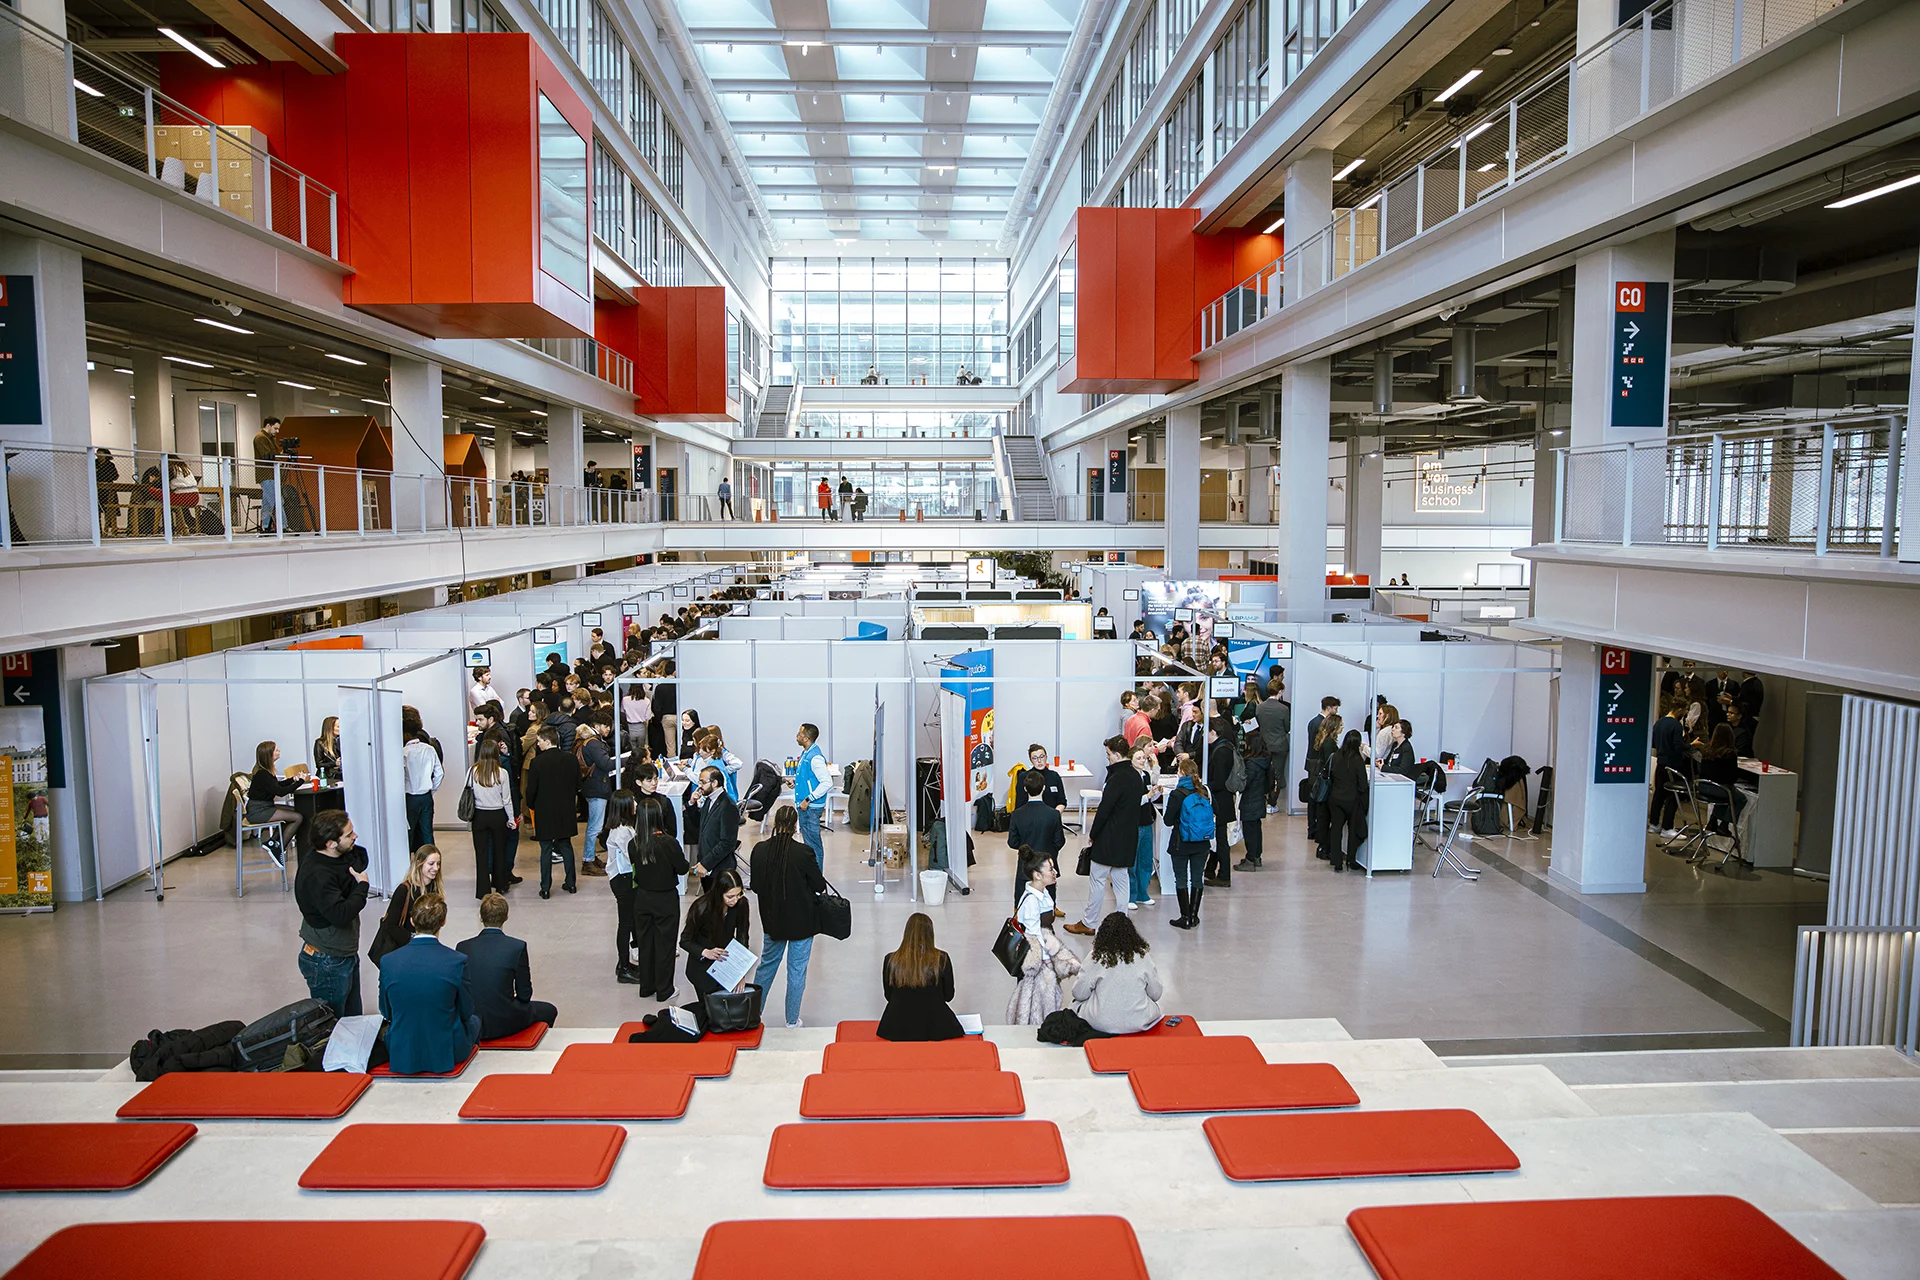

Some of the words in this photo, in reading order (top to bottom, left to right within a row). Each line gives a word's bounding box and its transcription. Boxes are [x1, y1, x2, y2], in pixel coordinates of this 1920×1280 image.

[1620, 287, 1641, 306] C0
[1422, 462, 1442, 471] em
[1422, 482, 1473, 494] business
[1422, 494, 1461, 506] school
[6, 653, 28, 671] D-1
[1605, 651, 1626, 669] C-1
